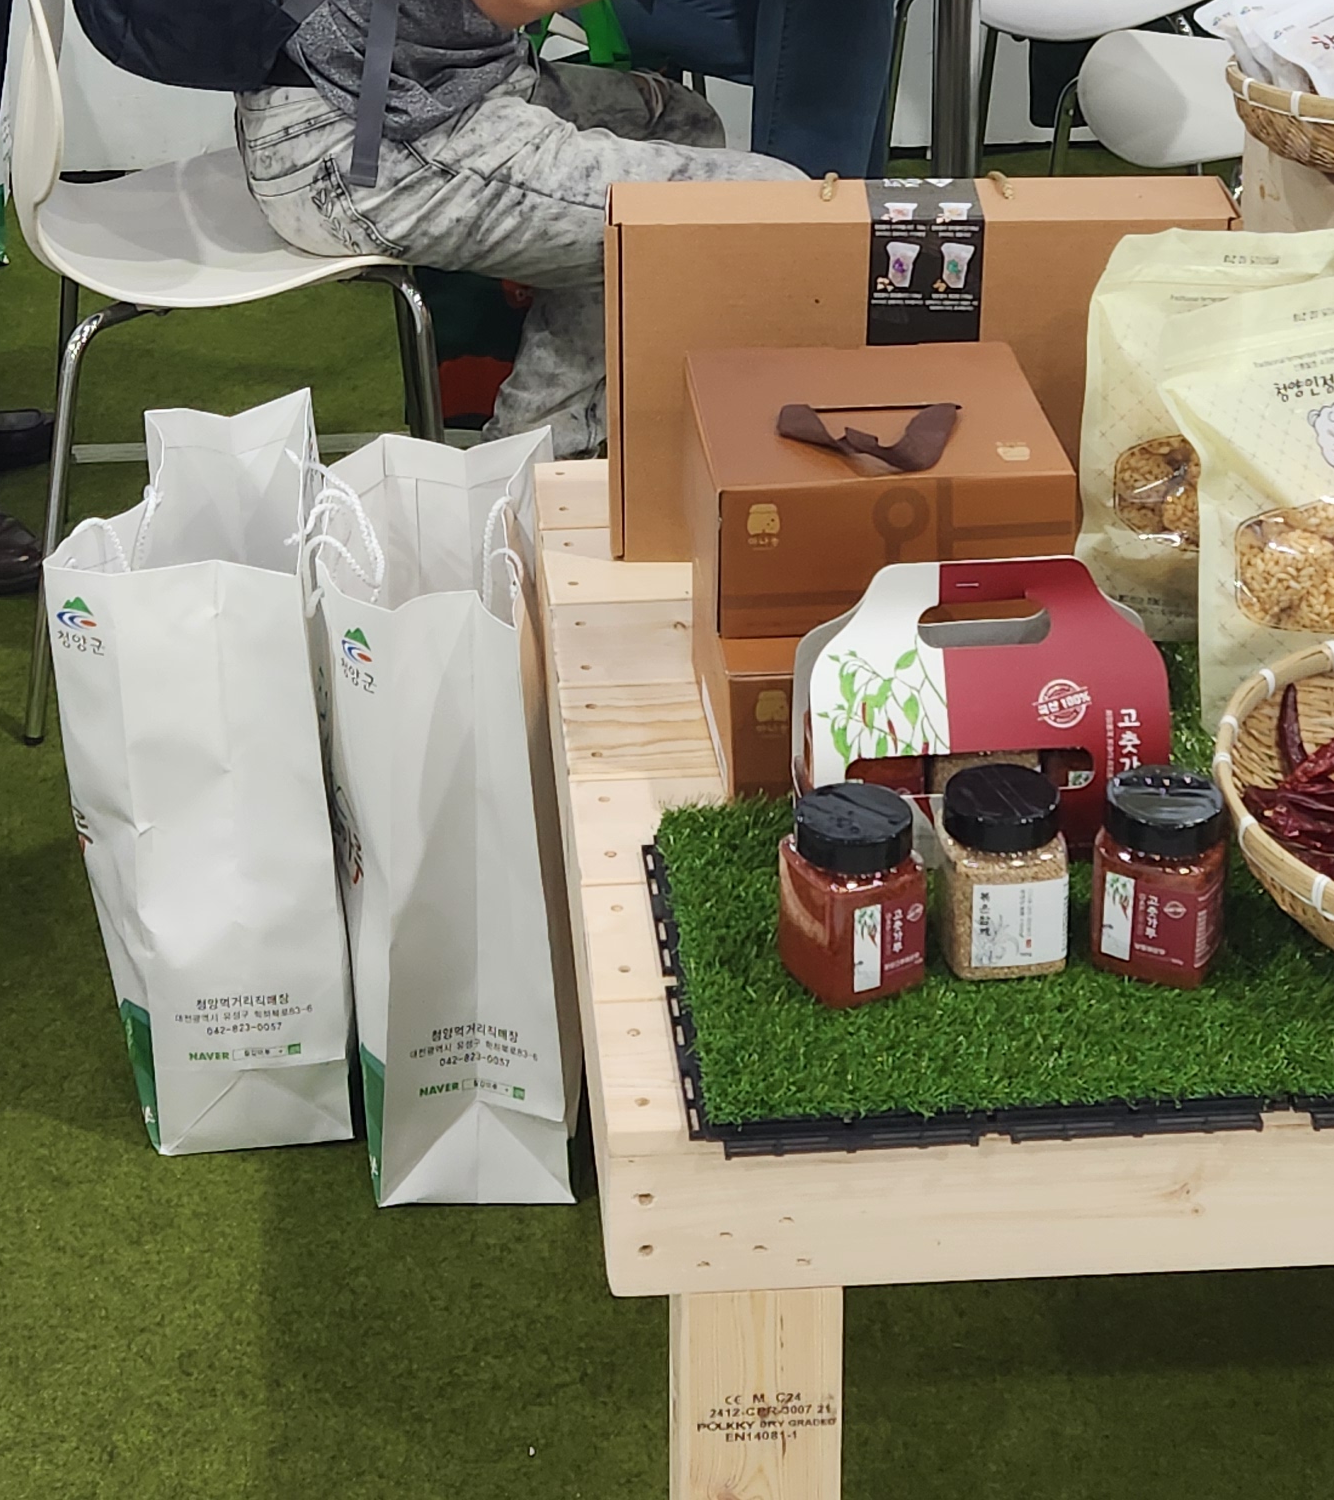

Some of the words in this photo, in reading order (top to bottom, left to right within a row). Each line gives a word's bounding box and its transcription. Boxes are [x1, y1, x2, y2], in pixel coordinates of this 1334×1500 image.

[57, 630, 105, 656] 청양군
[341, 657, 377, 694] 청양군
[1117, 708, 1141, 772] 고춧가
[188, 1051, 230, 1061] NAVER
[419, 1082, 459, 1097] NAVER
[775, 1392, 801, 1404] C24
[697, 1420, 755, 1432] POLKKY
[725, 1430, 797, 1442] EN14081-1
